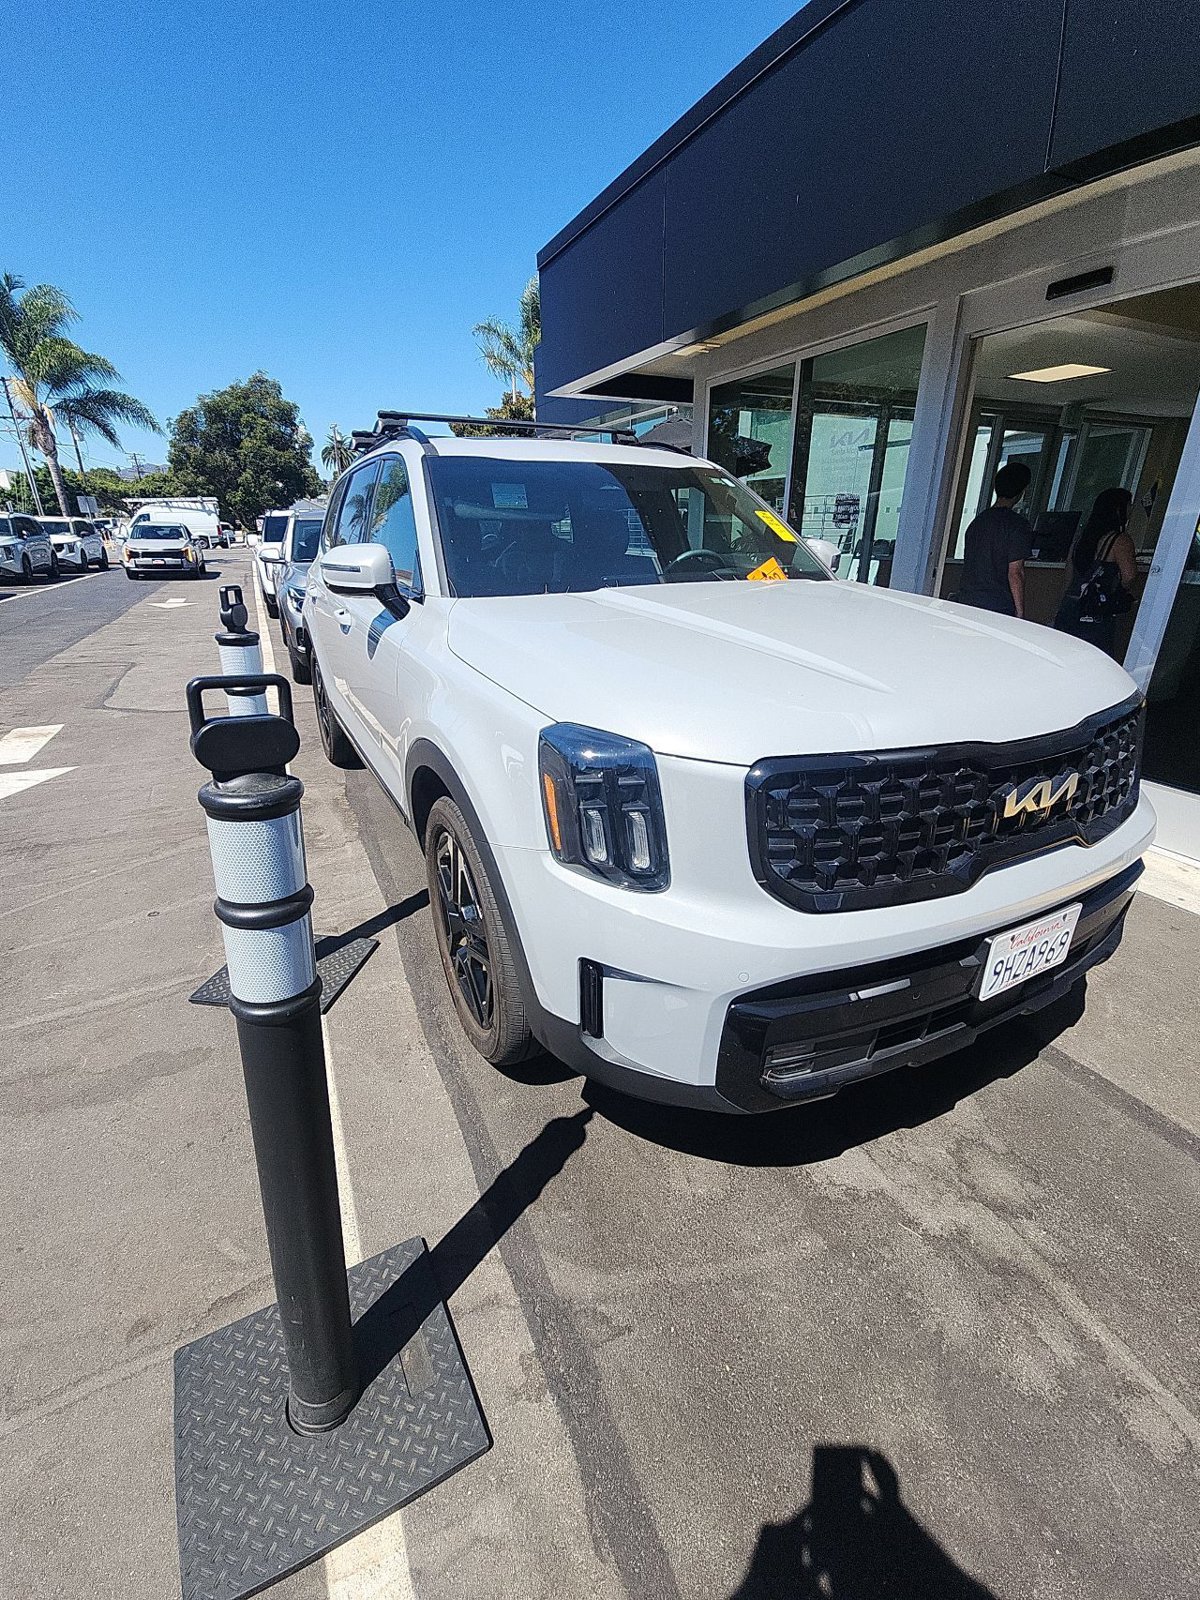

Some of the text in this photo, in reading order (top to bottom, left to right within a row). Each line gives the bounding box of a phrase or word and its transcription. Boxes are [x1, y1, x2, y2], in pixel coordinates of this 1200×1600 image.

[1003, 772, 1079, 818] KIA
[1009, 921, 1063, 949] California
[988, 930, 1070, 992] 9HZA969
